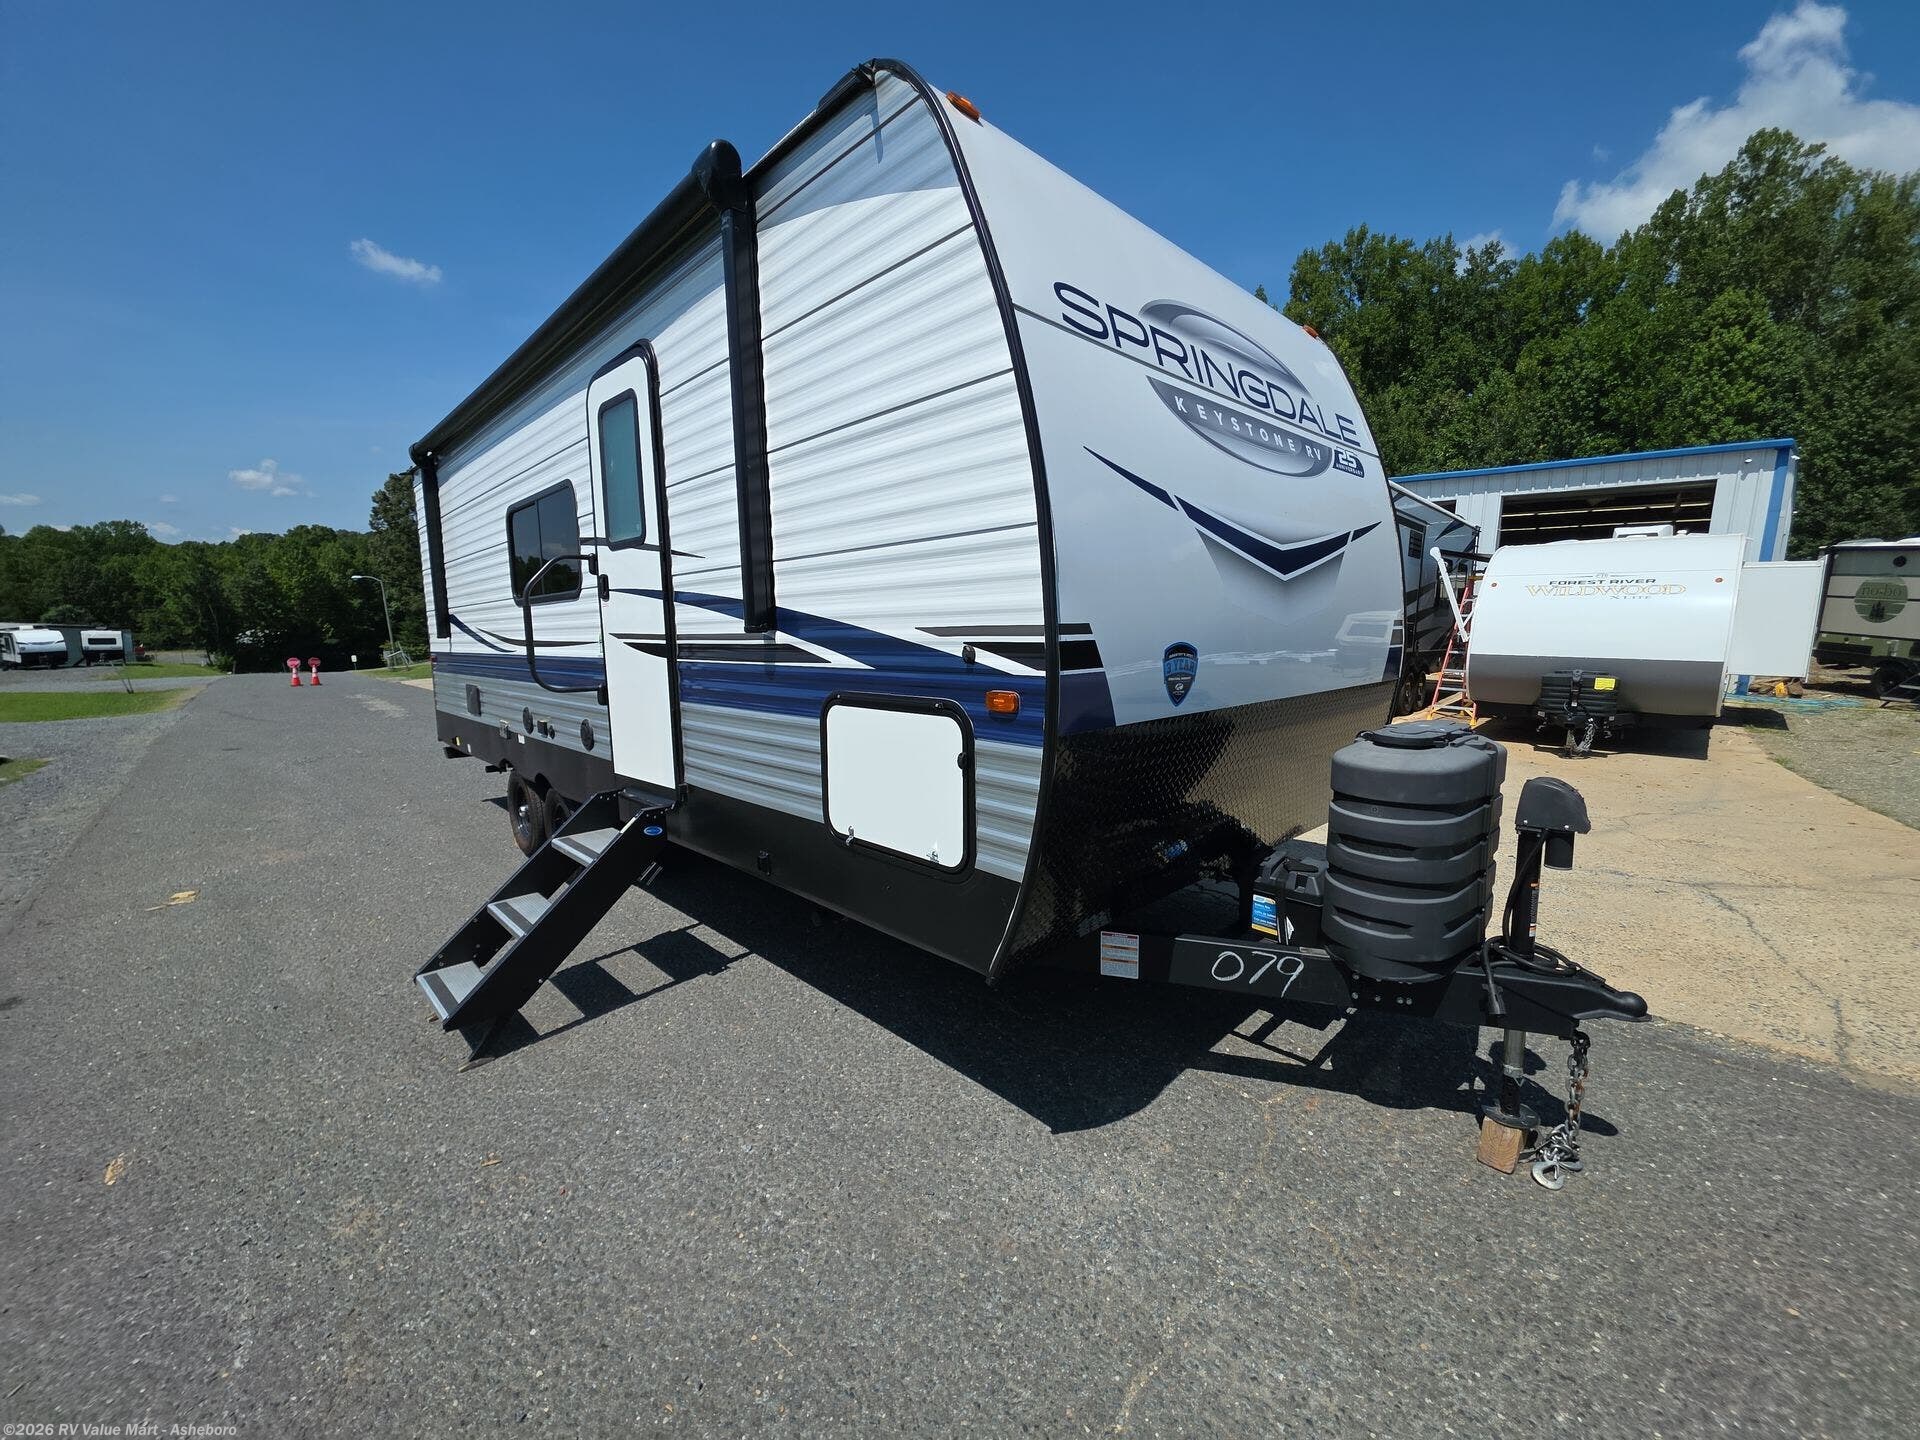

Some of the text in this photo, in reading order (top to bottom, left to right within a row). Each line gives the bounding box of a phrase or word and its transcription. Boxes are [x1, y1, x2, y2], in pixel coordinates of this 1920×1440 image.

[1053, 281, 1362, 447] SPRINGDALE
[1174, 395, 1323, 462] KEYSTONE RV
[1335, 446, 1358, 468] 25
[1525, 584, 1687, 597] WILDWOOD
[1211, 950, 1305, 998] 079
